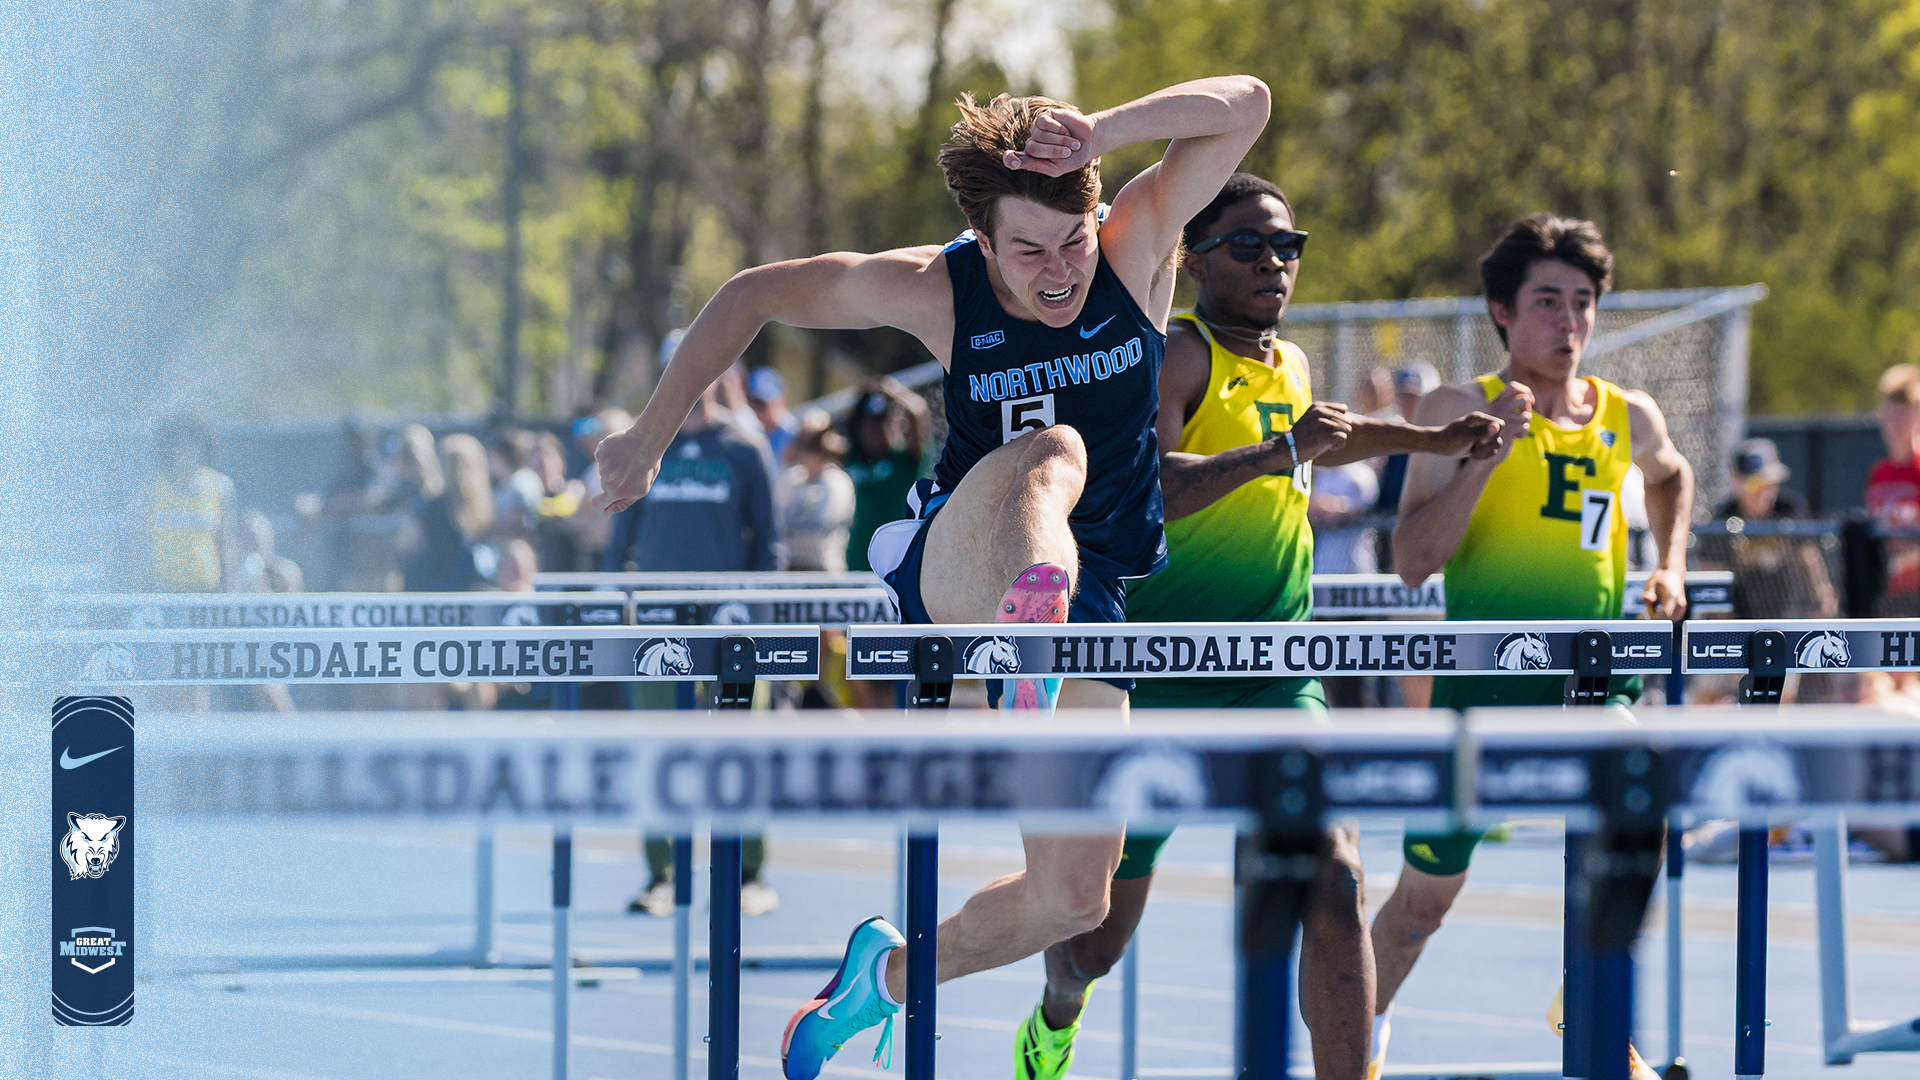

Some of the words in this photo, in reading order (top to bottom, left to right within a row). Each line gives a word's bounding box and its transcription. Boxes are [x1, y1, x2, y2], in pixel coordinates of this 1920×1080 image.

[968, 336, 1143, 403] NORTHWOOD
[1010, 400, 1048, 444] 5
[1540, 451, 1596, 522] E
[1588, 495, 1610, 544] 7
[351, 604, 473, 628] COLLEGE
[773, 601, 898, 623] HILLSDA
[171, 640, 402, 678] HILLSDALE
[413, 639, 595, 676] COLLEGE
[755, 649, 808, 664] UCS
[856, 649, 909, 664] UCS
[1051, 635, 1273, 673] HILLSDALE
[1283, 634, 1457, 671] COLLEGE
[1611, 645, 1662, 658] UCS
[1692, 644, 1743, 658] UCS
[654, 746, 1015, 816] COLLEGE
